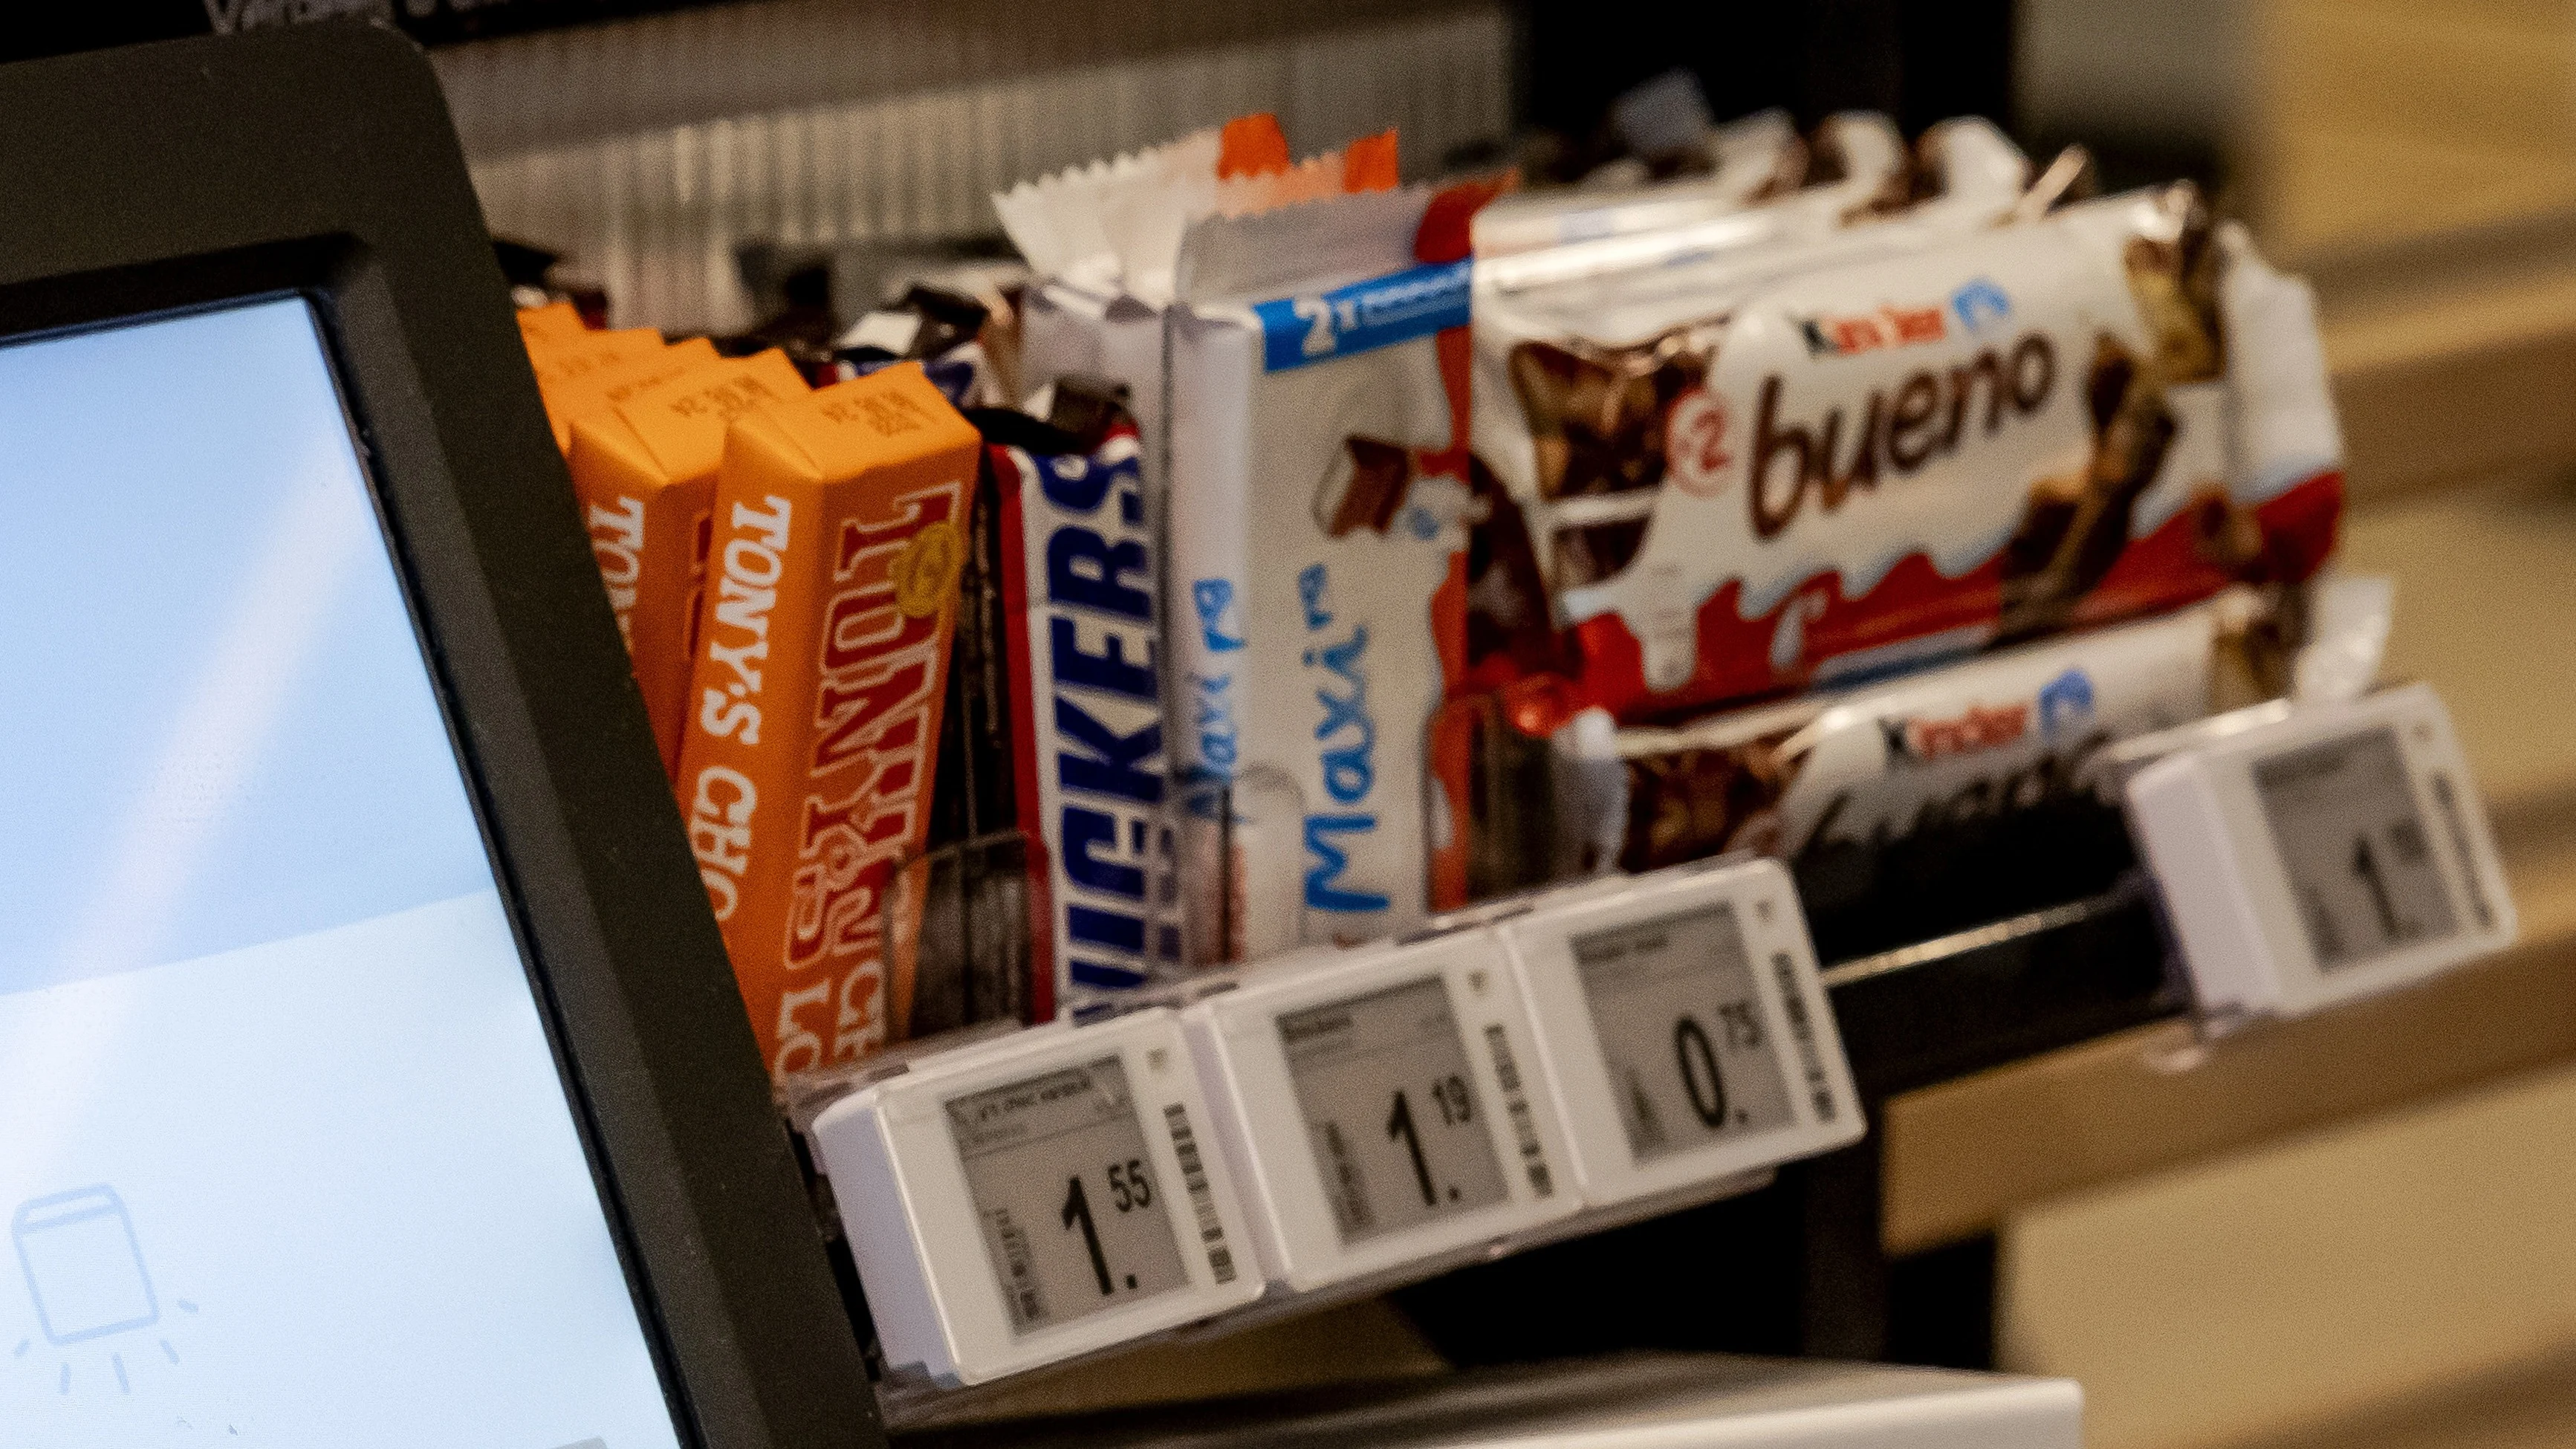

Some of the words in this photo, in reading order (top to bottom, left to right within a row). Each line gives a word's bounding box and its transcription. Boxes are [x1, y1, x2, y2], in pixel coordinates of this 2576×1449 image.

[1747, 332, 2058, 540] bueno
[701, 494, 791, 746] TONY'S
[782, 481, 963, 970] TONY'S
[1302, 624, 1391, 912] Maxi
